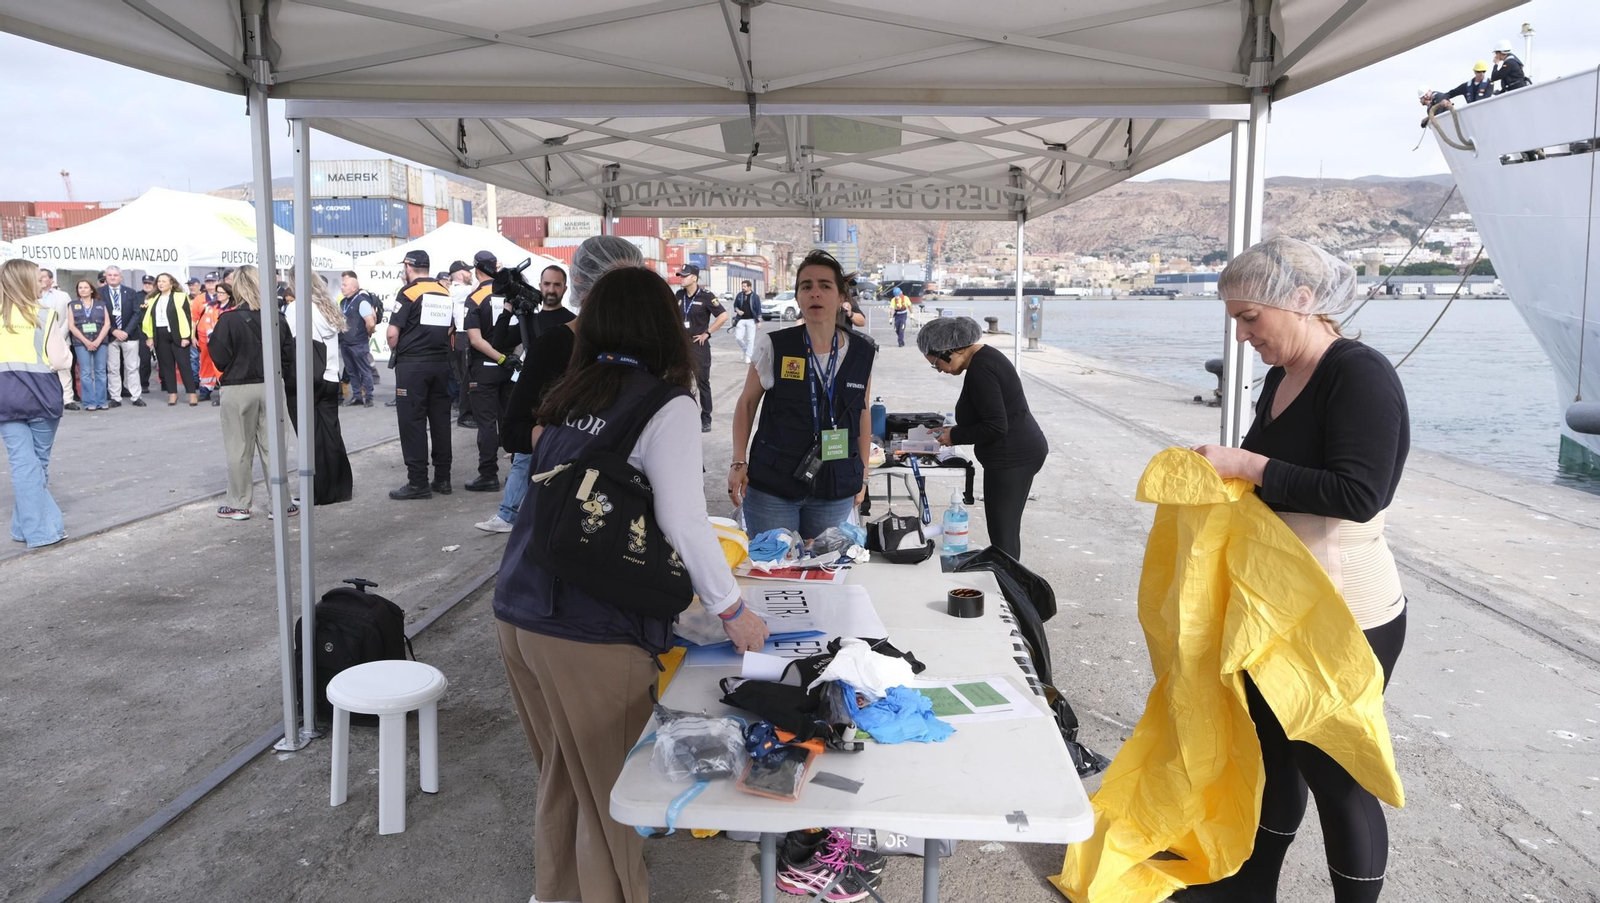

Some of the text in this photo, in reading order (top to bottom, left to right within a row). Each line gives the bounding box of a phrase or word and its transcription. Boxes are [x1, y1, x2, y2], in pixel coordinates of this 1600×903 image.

[327, 172, 379, 182] MAERSK
[21, 245, 179, 262] PUESTO DE MANDO AVANZADO
[221, 251, 254, 264] PUESTO
[275, 254, 295, 266] ANDO
[763, 590, 810, 618] RETIR
